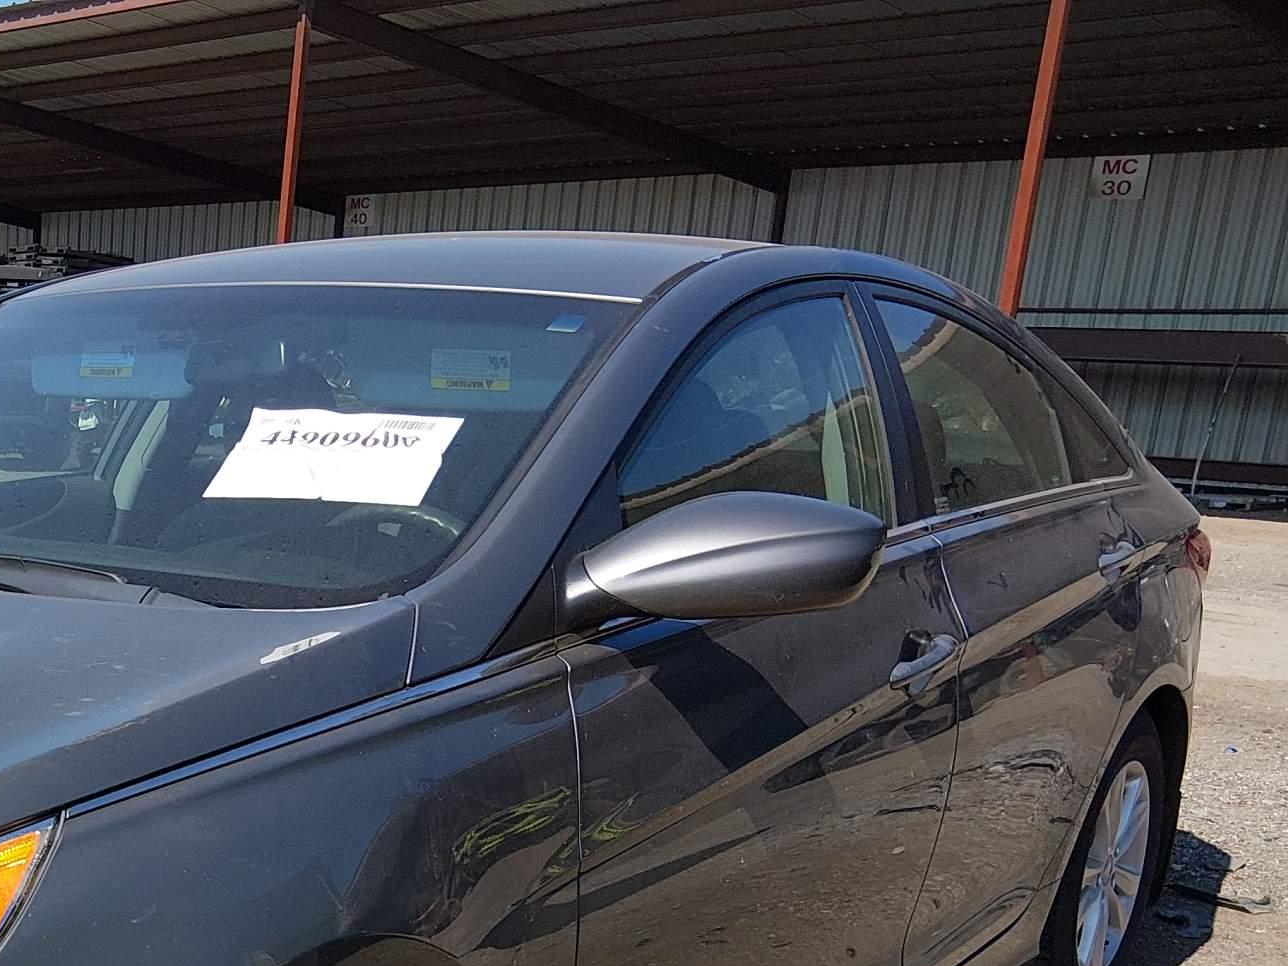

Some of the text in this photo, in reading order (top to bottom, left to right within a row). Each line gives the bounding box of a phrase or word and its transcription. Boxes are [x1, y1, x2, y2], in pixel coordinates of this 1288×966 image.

[1102, 158, 1139, 175] MC
[1101, 180, 1132, 196] 30
[350, 197, 370, 209] MC
[351, 212, 367, 225] 40
